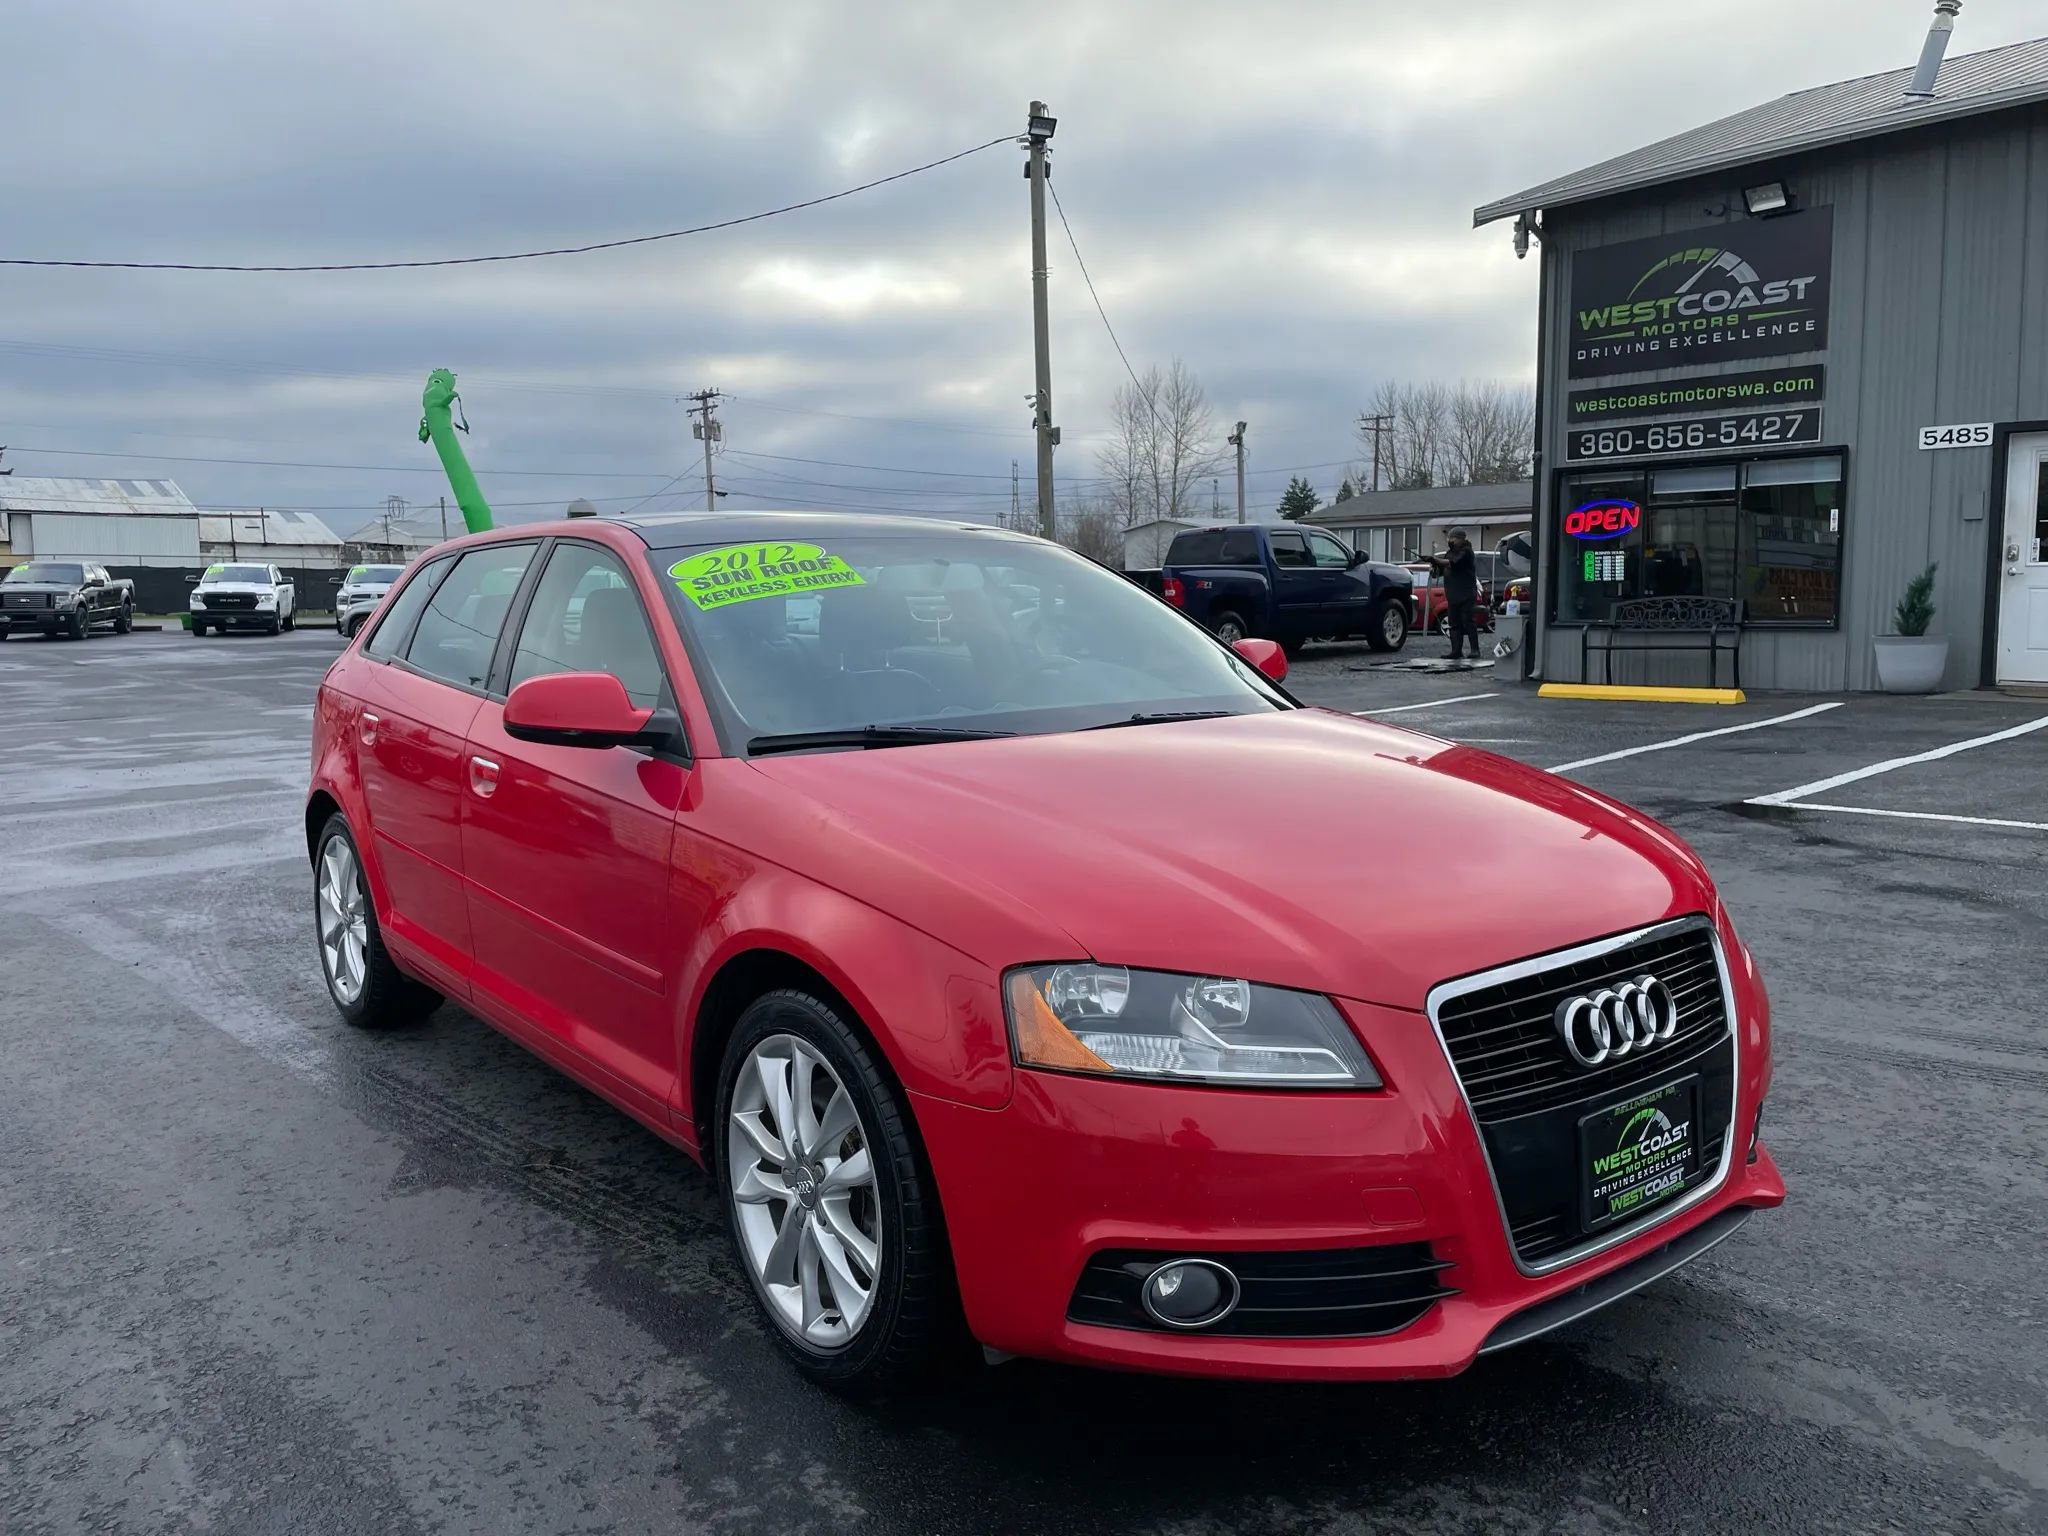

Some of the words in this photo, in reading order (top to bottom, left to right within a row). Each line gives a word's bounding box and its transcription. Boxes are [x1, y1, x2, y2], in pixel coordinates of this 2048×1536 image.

[1579, 276, 1816, 330] WESTCOAST
[1577, 340, 1660, 361] DRIVING
[1669, 319, 1816, 348] EXCELLENCE
[1642, 313, 1739, 337] MOTORS
[1575, 377, 1814, 413] westcoastmotorswa.com
[1580, 414, 1804, 456] 360-656-5427
[1923, 426, 1989, 446] 5485
[1565, 506, 1640, 534] OPEN
[691, 569, 754, 592] SUN
[759, 557, 834, 579] ROOF
[702, 545, 796, 575] 2012
[697, 580, 790, 606] KEYLESS
[791, 570, 856, 588] ENTRY
[1593, 1121, 1690, 1175] WESTCOAST
[1625, 1149, 1667, 1175] MOTORS
[1593, 1174, 1635, 1198] DRIVING
[1637, 1147, 1692, 1179] EXCELLENCE
[1610, 1166, 1685, 1213] WESTCOAST
